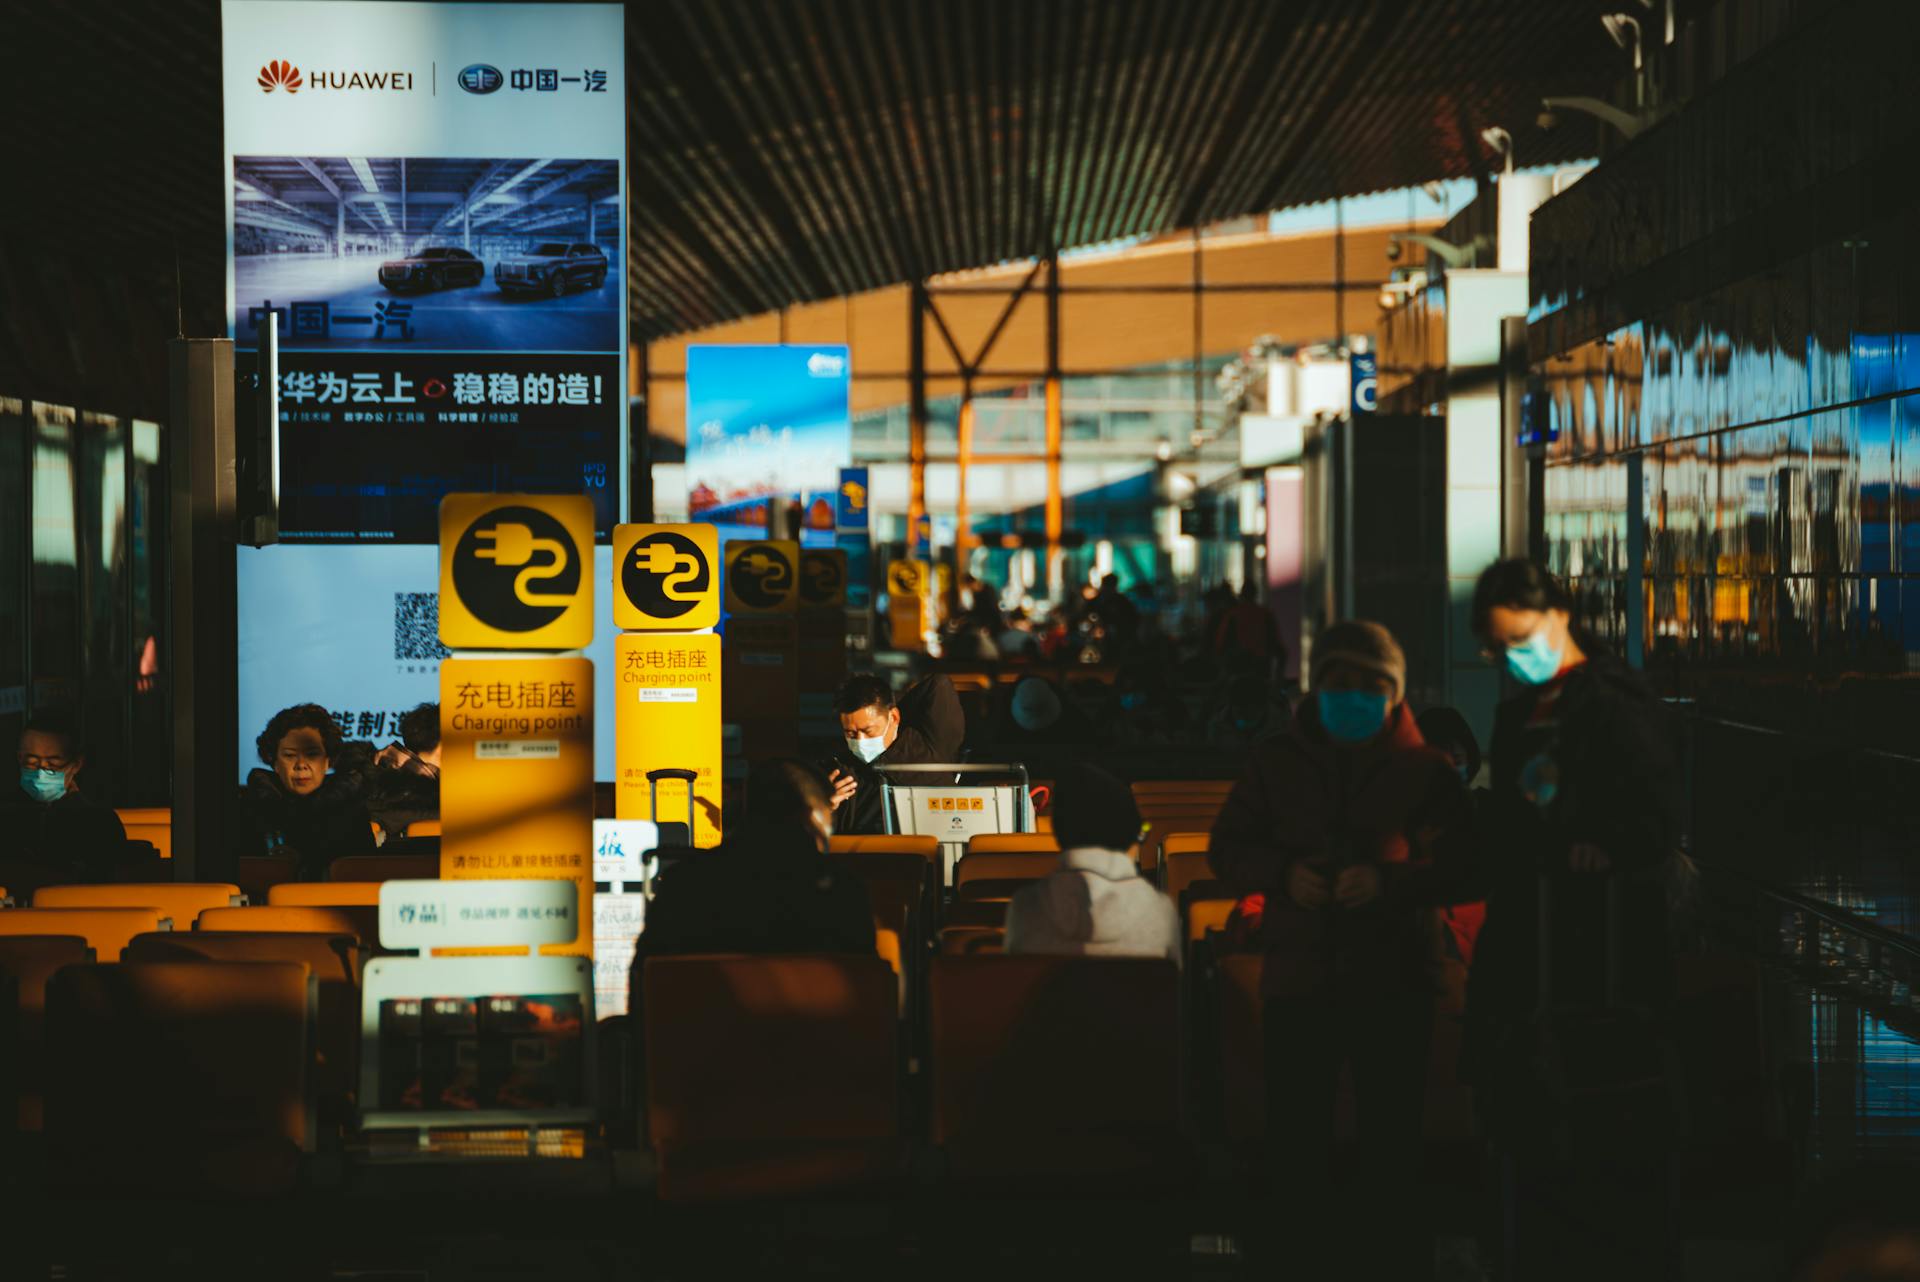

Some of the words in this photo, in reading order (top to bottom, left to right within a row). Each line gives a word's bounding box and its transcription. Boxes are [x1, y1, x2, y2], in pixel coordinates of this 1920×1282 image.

[310, 71, 413, 91] HUAWEI
[510, 69, 607, 93] 中国一汽
[278, 370, 416, 405] 华为云上
[624, 649, 708, 670] 充电插座
[623, 671, 677, 686] Charging
[679, 671, 712, 685] point
[455, 680, 577, 710] 充电插座
[452, 713, 530, 735] Charging
[533, 713, 583, 734] point
